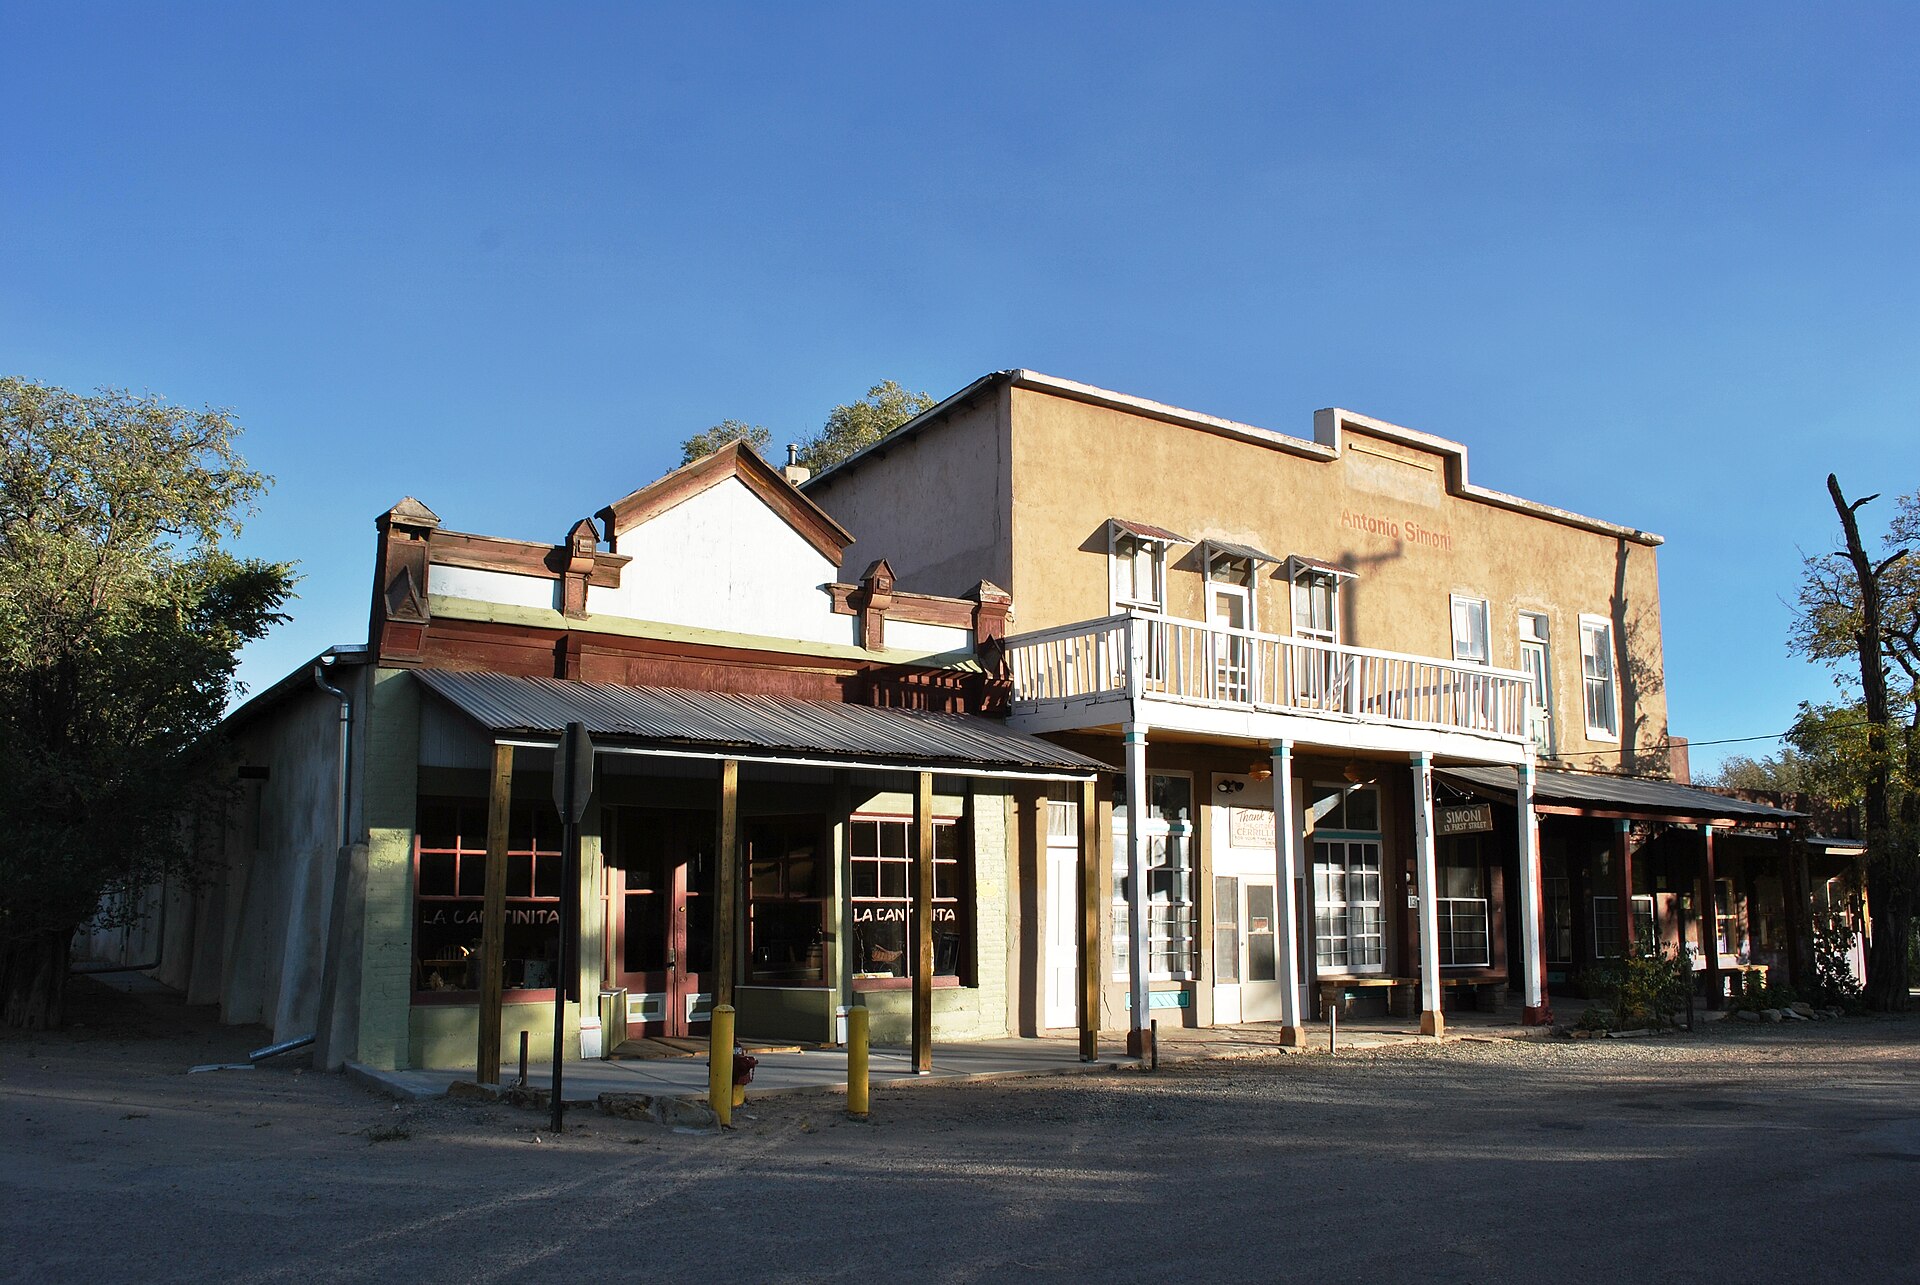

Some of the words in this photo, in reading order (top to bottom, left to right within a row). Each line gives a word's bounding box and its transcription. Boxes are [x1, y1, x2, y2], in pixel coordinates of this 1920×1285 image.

[1340, 508, 1399, 539] Antonio
[1404, 520, 1452, 551] Simoni
[1235, 809, 1265, 823] Thank
[1446, 809, 1481, 823] SIMONI
[1443, 824, 1450, 832] 13
[1451, 822, 1467, 831] FIRST
[1468, 821, 1487, 830] STREET
[1409, 897, 1417, 907] 13
[423, 909, 447, 924] LA
[853, 908, 873, 922] LA
[876, 908, 956, 922] CANITA
